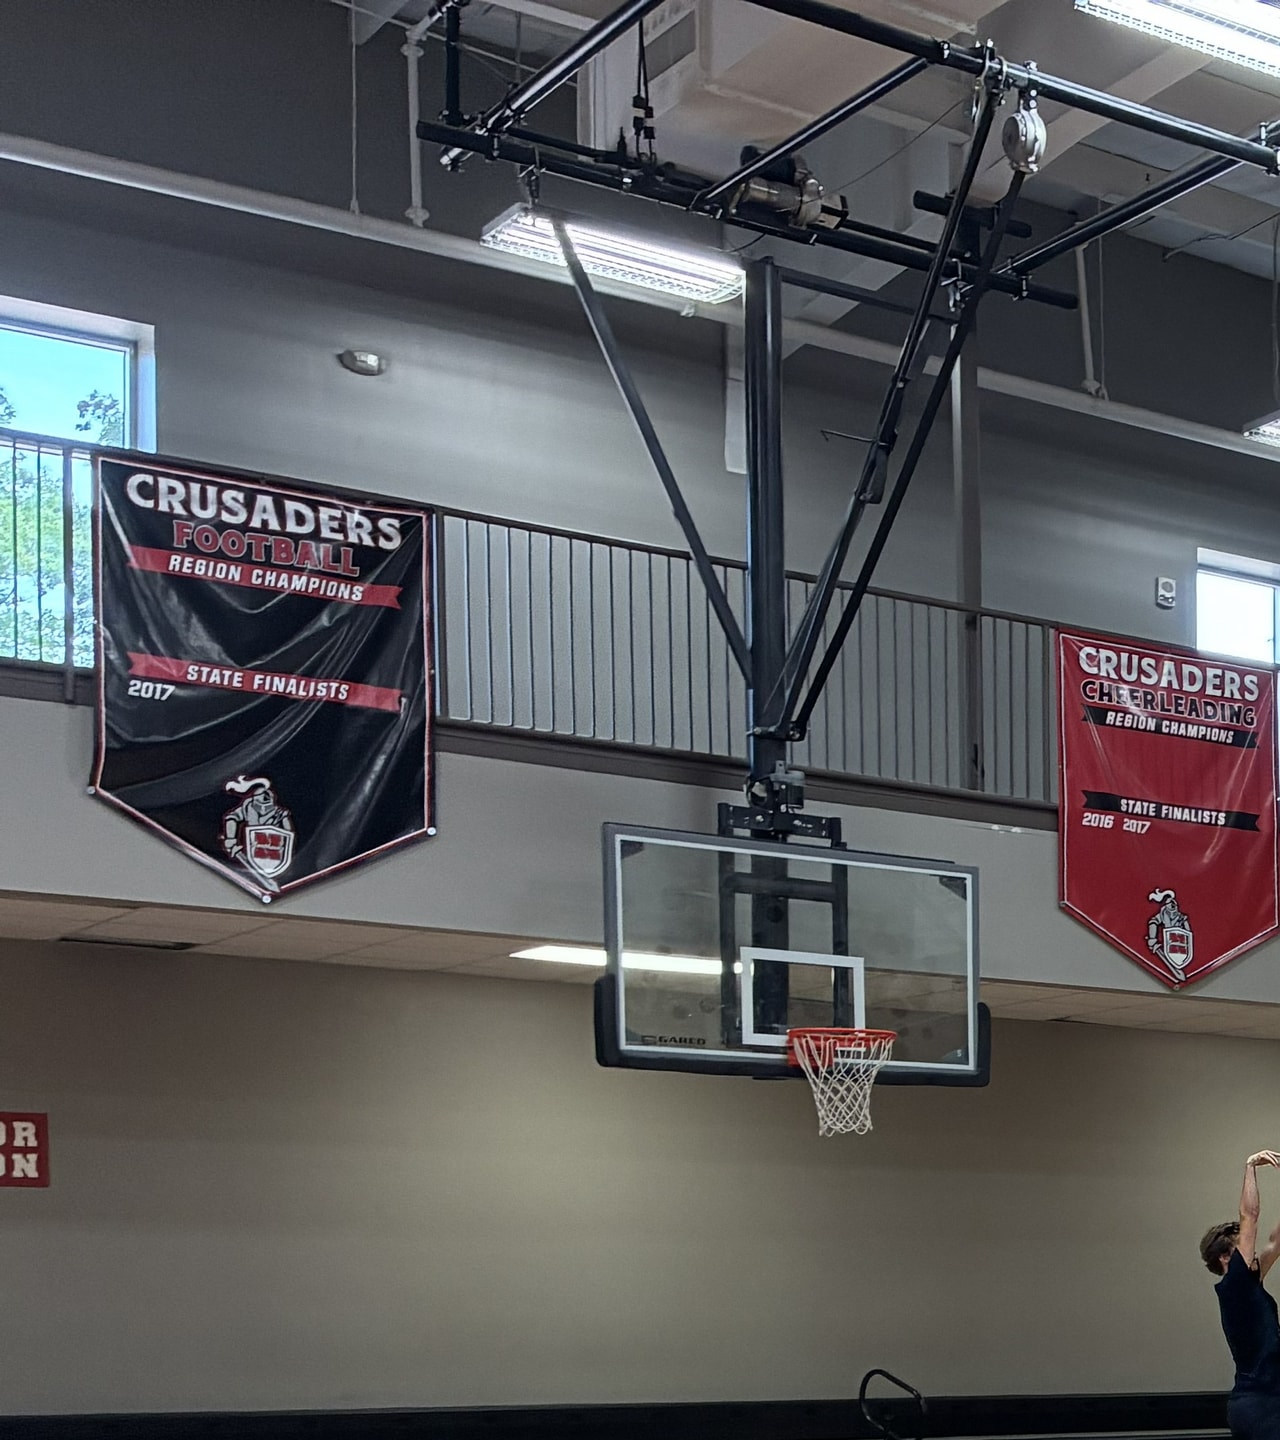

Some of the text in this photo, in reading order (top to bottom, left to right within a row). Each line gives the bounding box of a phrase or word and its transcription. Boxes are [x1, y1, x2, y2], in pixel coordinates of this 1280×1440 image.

[126, 473, 402, 550] CRUSADERS
[172, 520, 360, 577] FOOTBALL
[168, 554, 364, 602] REGION CHAMPIONS
[127, 680, 175, 702] 2017
[186, 664, 349, 701] STATE FINALISTS
[1079, 647, 1260, 701] CRUSADERS
[1081, 680, 1256, 727] CHEERLEADING
[1105, 711, 1234, 744] REGION CHAMPIONS
[1082, 812, 1151, 835] 2016 2017
[1120, 798, 1226, 826] STATE FINALISTS
[0, 1121, 38, 1147] R
[0, 1153, 39, 1178] N
